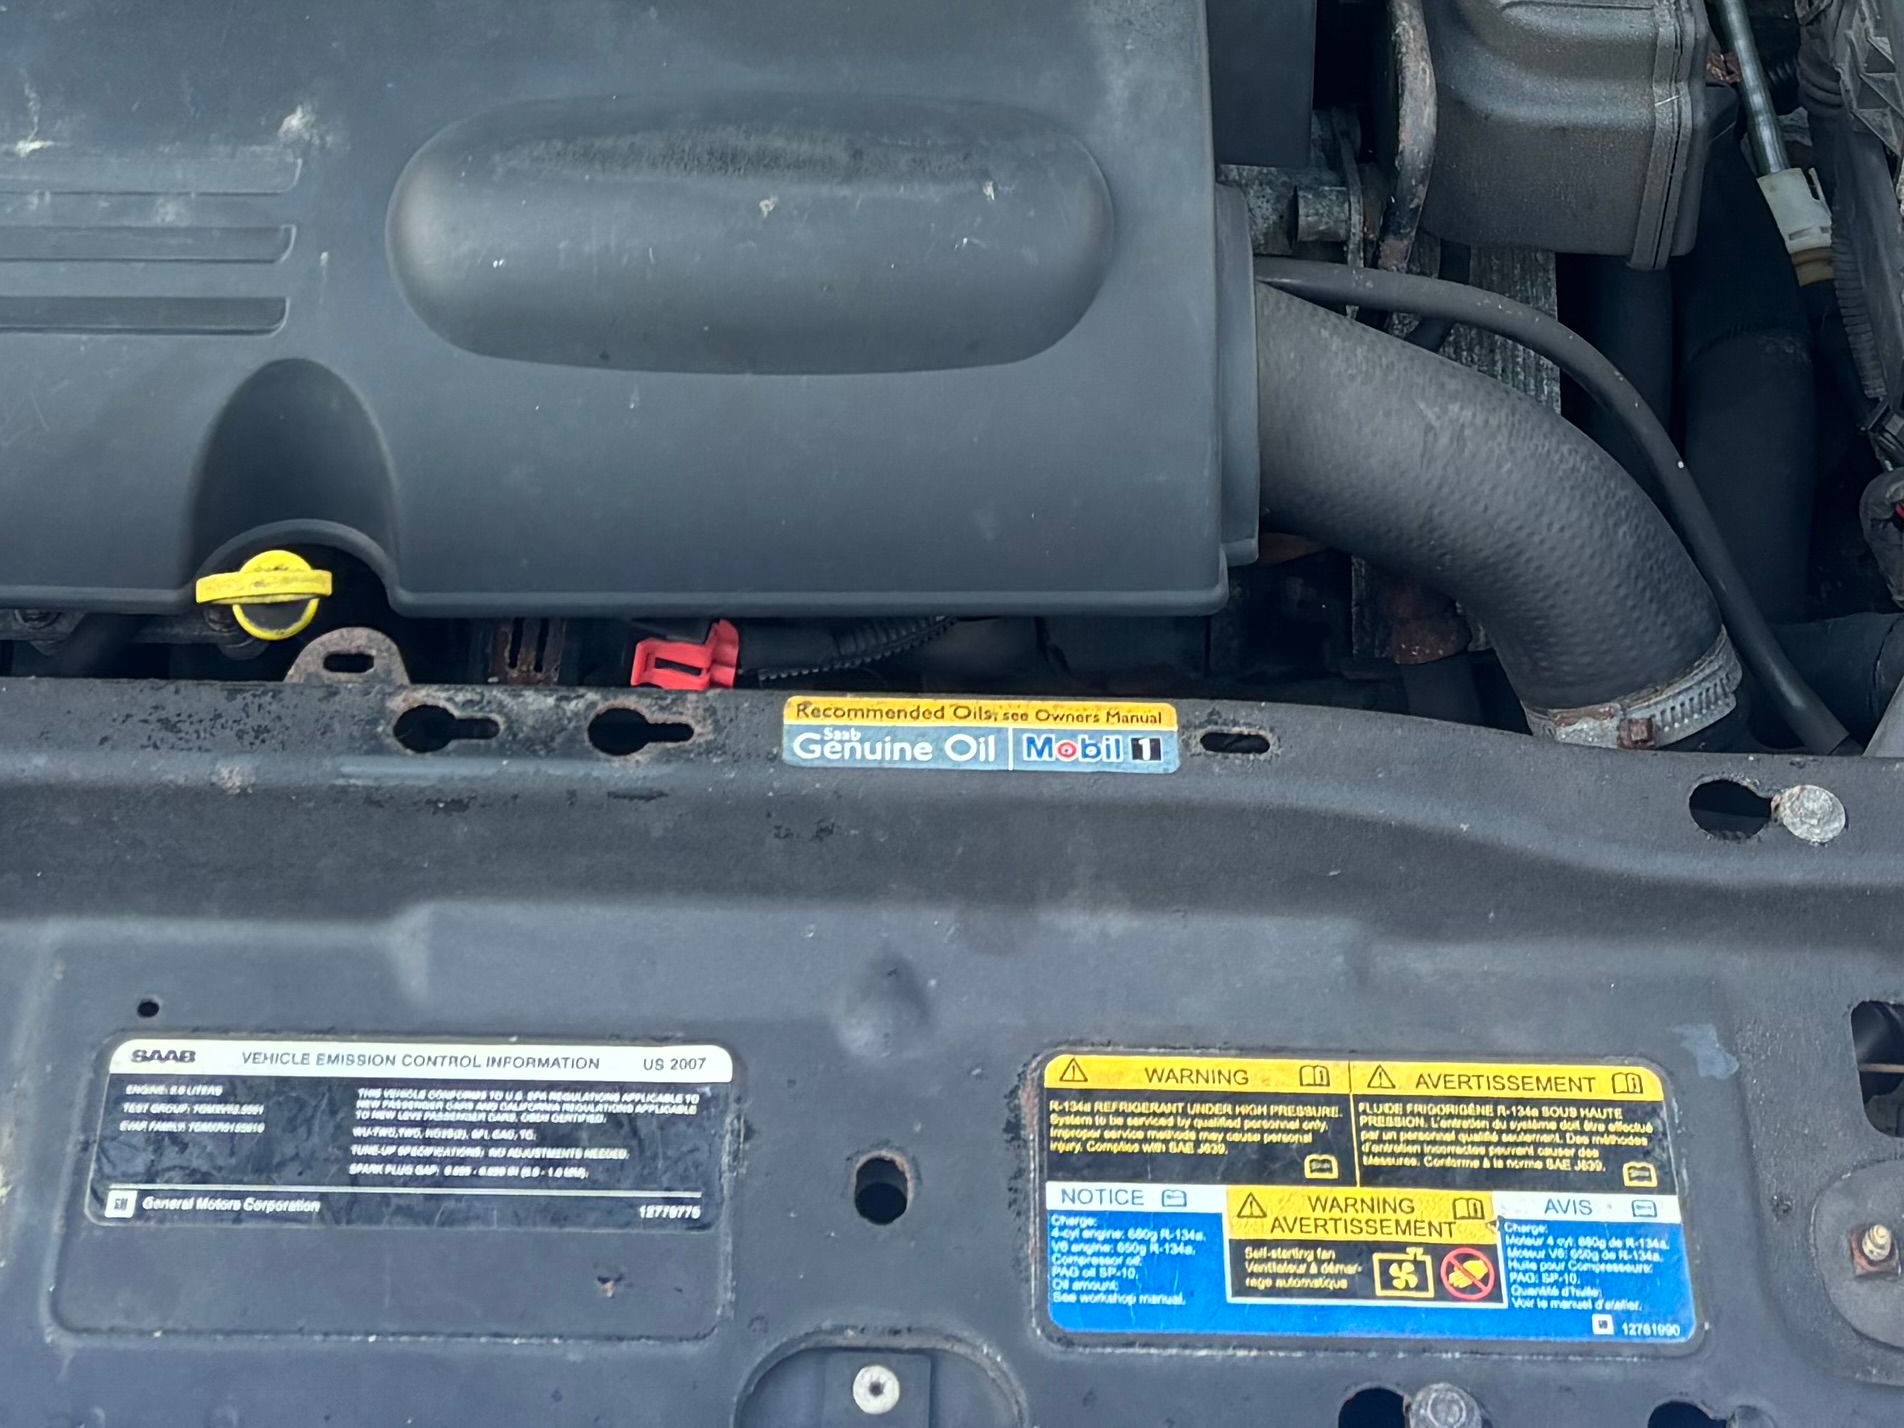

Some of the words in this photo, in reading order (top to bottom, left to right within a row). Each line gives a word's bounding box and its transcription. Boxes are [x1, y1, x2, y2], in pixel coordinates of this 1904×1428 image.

[797, 703, 945, 722] Recommended
[1002, 710, 1029, 723] see
[1036, 709, 1100, 725] Owners
[1106, 709, 1162, 726] Manual
[823, 727, 861, 741] Saab
[793, 732, 934, 761] Genuine
[945, 733, 995, 762] Oil
[1022, 735, 1124, 762] Mobil
[1135, 737, 1158, 762] 1
[130, 1049, 196, 1064] SAAB
[242, 1051, 311, 1066] VEHICLE
[316, 1053, 396, 1067] EMISSION
[401, 1054, 482, 1068] CONTROL
[486, 1055, 600, 1070] INFORMATION
[643, 1058, 665, 1071] US
[670, 1057, 707, 1071] 2007
[1146, 1067, 1250, 1086] WARNING
[1415, 1072, 1596, 1094] AVERTISSEMENT
[1187, 1102, 1233, 1115] UNDER
[1541, 1106, 1578, 1118] SOUS
[1580, 1107, 1623, 1120] HAUTE
[142, 1196, 195, 1211] General
[196, 1197, 241, 1211] Motors
[243, 1197, 321, 1214] Corporation
[1060, 1188, 1145, 1206] NOTICE
[1307, 1195, 1416, 1215] WARNING
[1544, 1198, 1594, 1216] AVIS
[1269, 1217, 1457, 1240] AVERTISSEMENT
